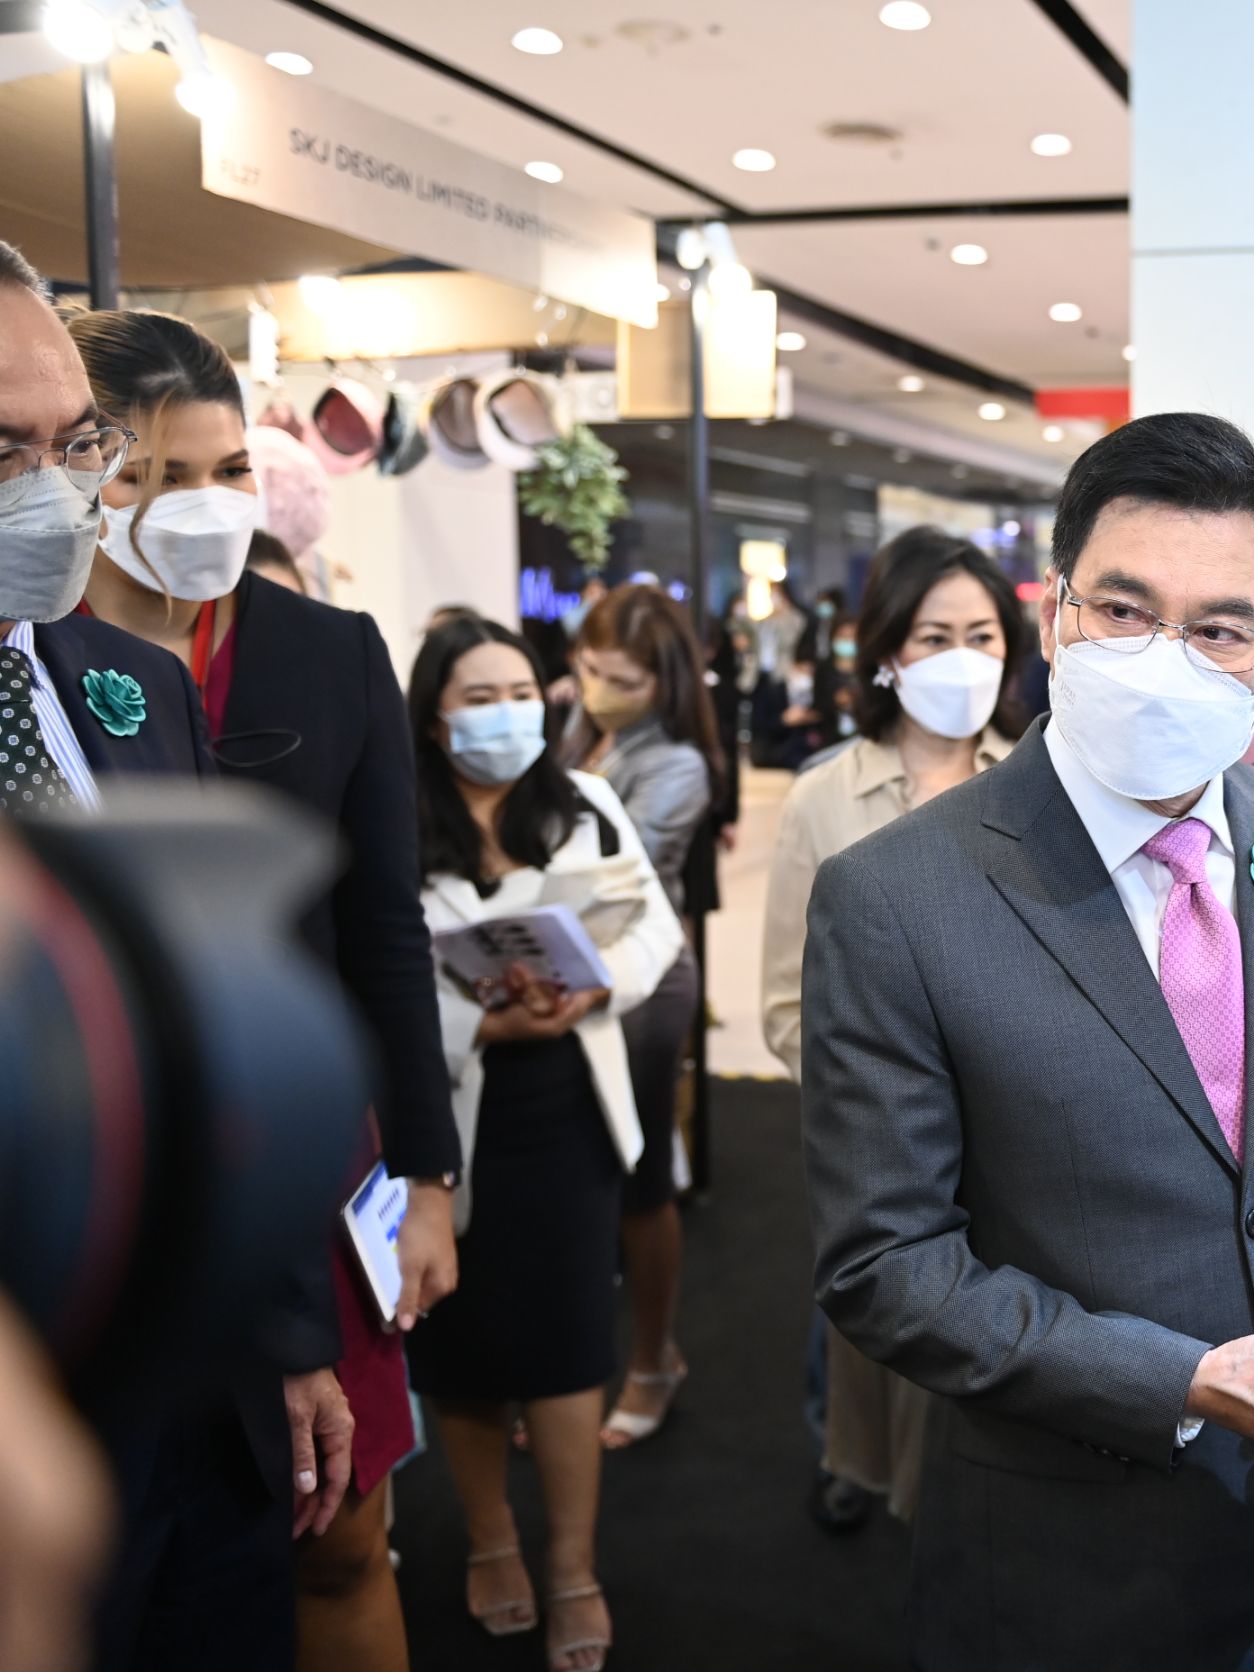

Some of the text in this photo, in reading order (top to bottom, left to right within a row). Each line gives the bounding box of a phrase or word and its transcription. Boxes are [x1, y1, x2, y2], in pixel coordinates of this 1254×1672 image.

[289, 127, 331, 165] SKJ
[335, 144, 413, 194] DESIGN
[416, 176, 490, 222] LIMITED
